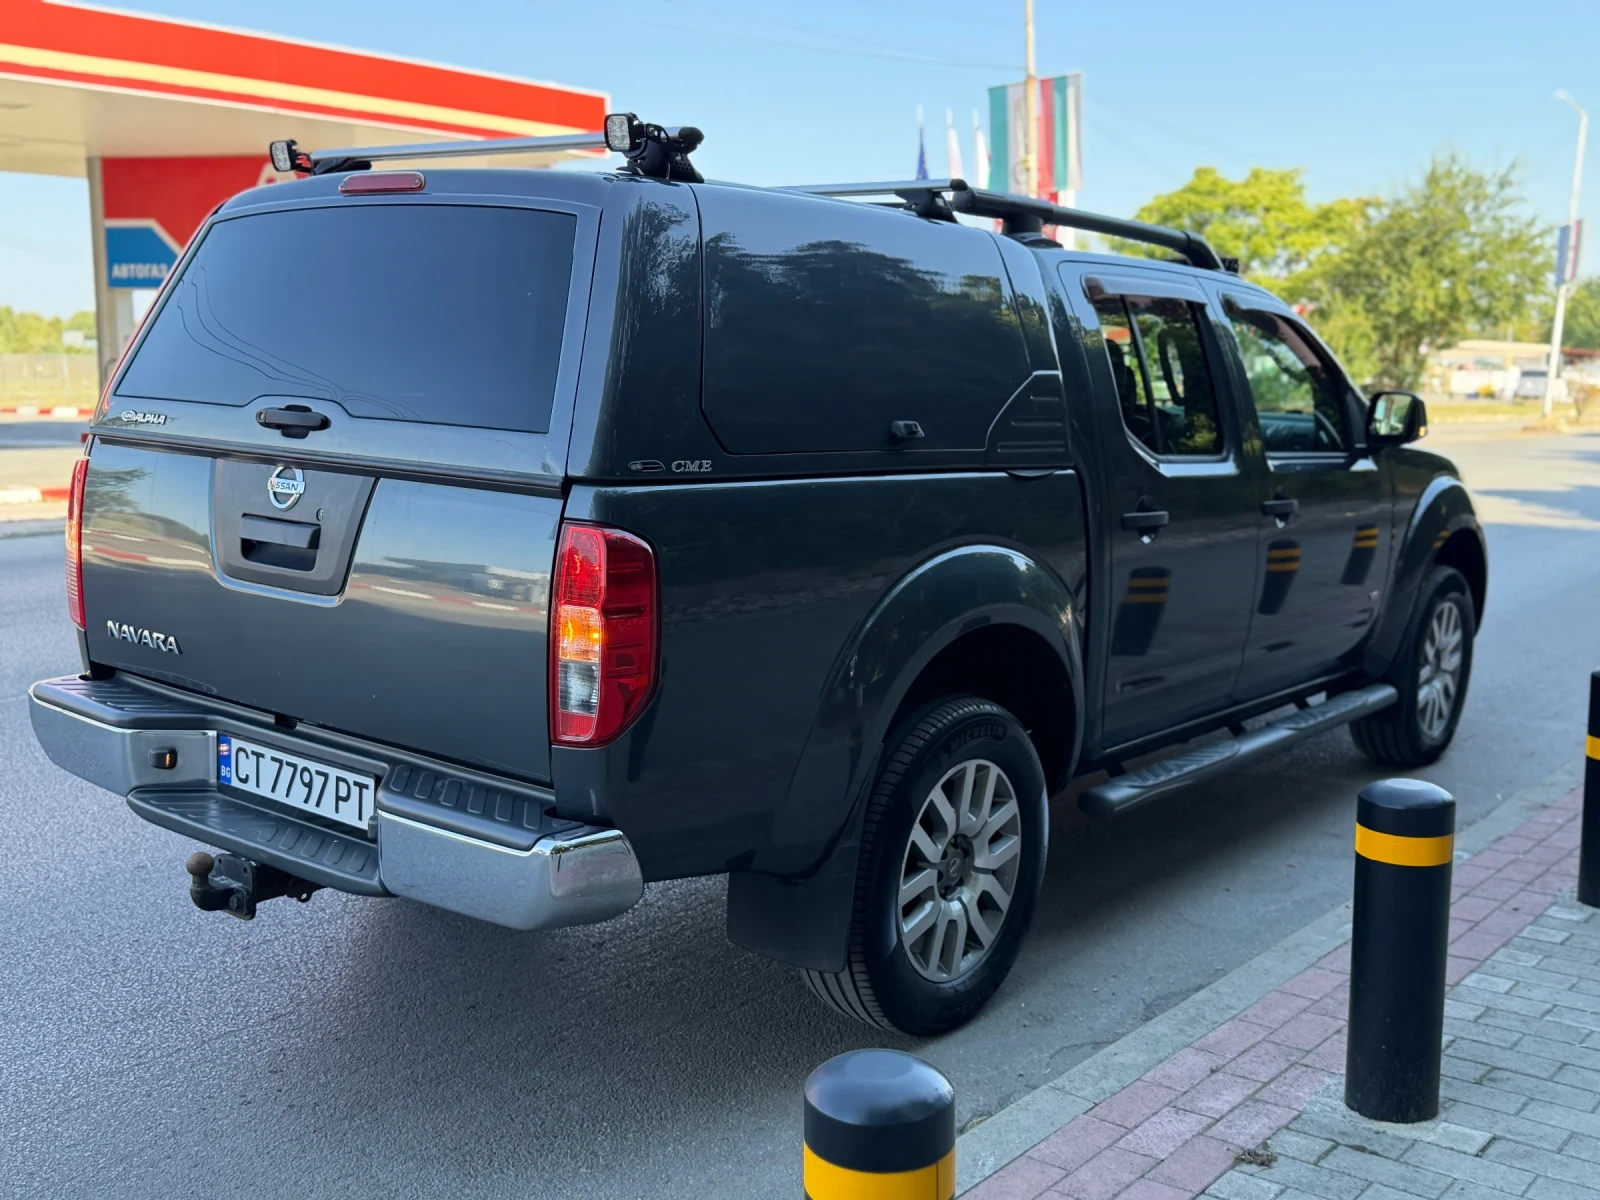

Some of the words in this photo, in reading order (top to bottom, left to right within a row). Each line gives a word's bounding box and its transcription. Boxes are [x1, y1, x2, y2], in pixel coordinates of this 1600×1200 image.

[111, 262, 168, 279] АВТОГАЗ
[133, 413, 166, 425] ALPHA
[671, 460, 712, 472] CME
[107, 620, 180, 655] NAVARA
[221, 765, 231, 778] BG
[235, 746, 265, 788] CT
[270, 756, 330, 808] 7797
[334, 775, 370, 821] PT
